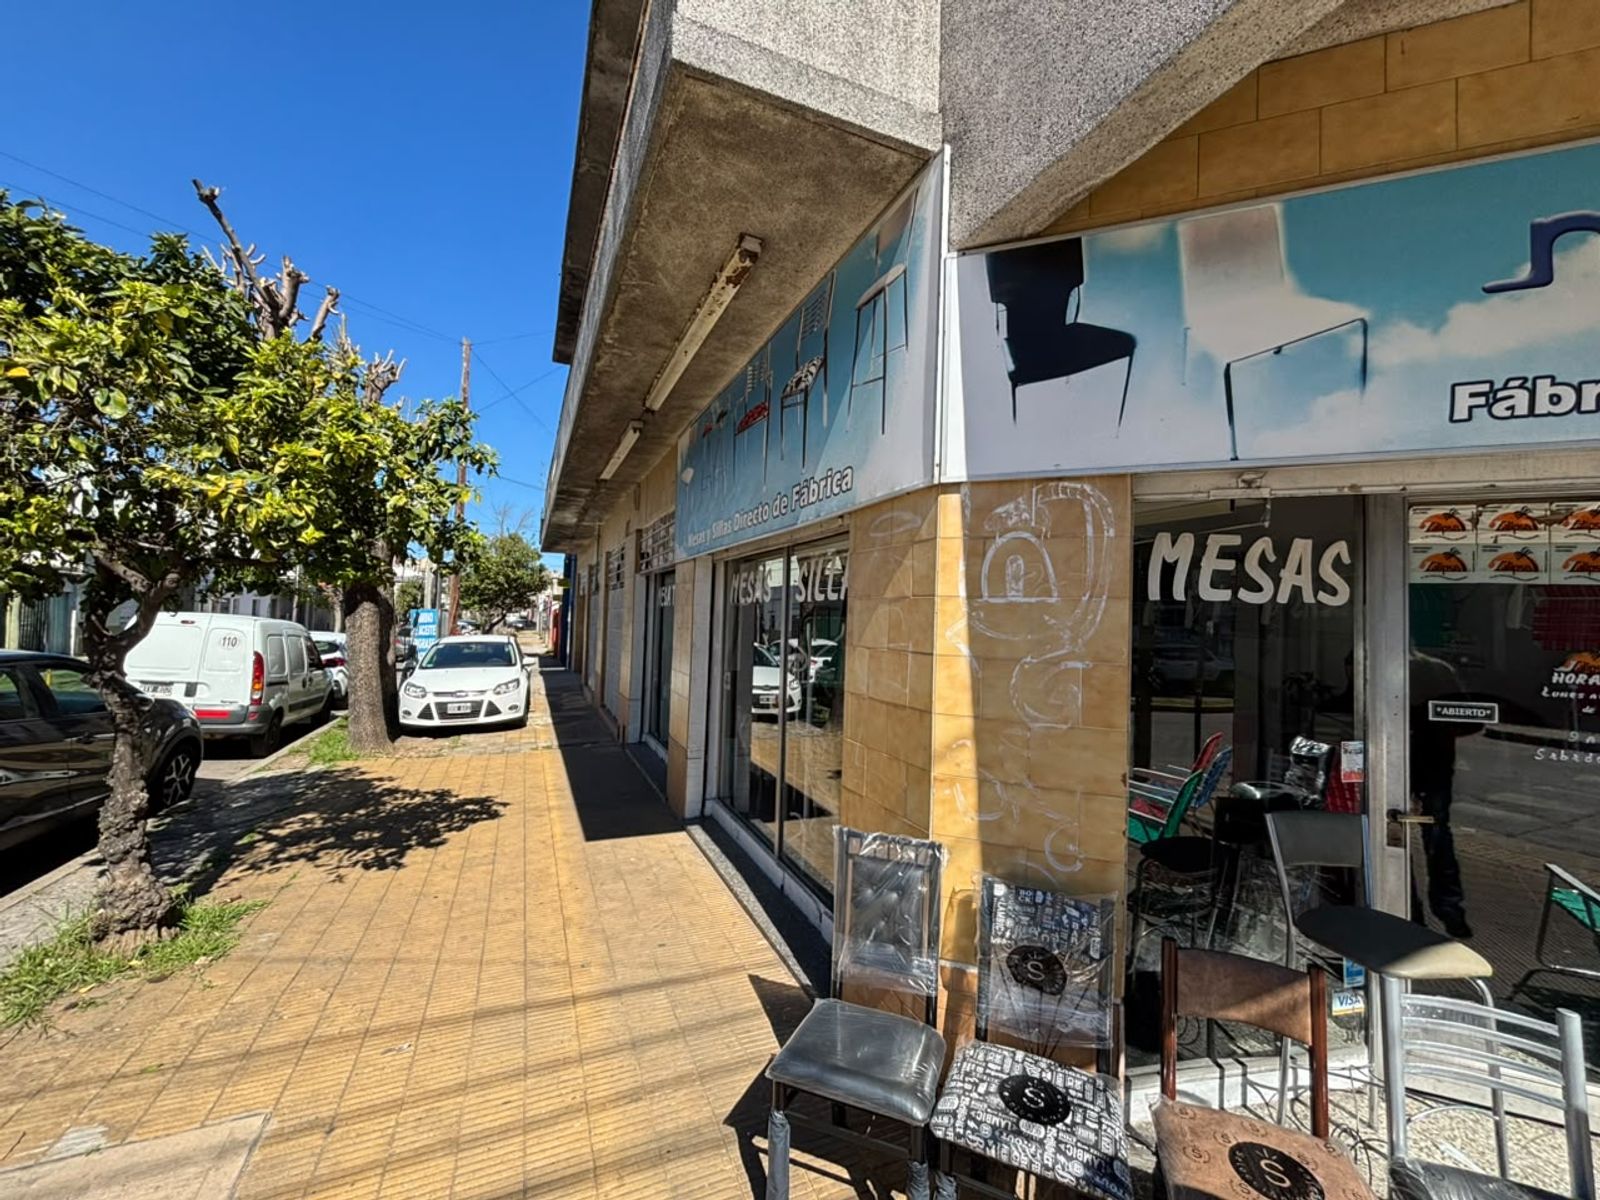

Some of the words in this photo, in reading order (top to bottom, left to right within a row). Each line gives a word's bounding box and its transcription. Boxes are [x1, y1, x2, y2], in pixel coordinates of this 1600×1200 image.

[733, 503, 769, 531] Directo
[771, 491, 788, 519] de
[791, 465, 853, 512] Fábrica
[1147, 531, 1352, 607] MESAS
[731, 566, 773, 605] MESAS
[221, 636, 239, 648] 110
[1540, 686, 1585, 700] Lunes
[1026, 960, 1046, 982] S
[1337, 992, 1361, 1007] VISA
[1022, 1086, 1045, 1109] S
[1259, 1159, 1291, 1188] S
